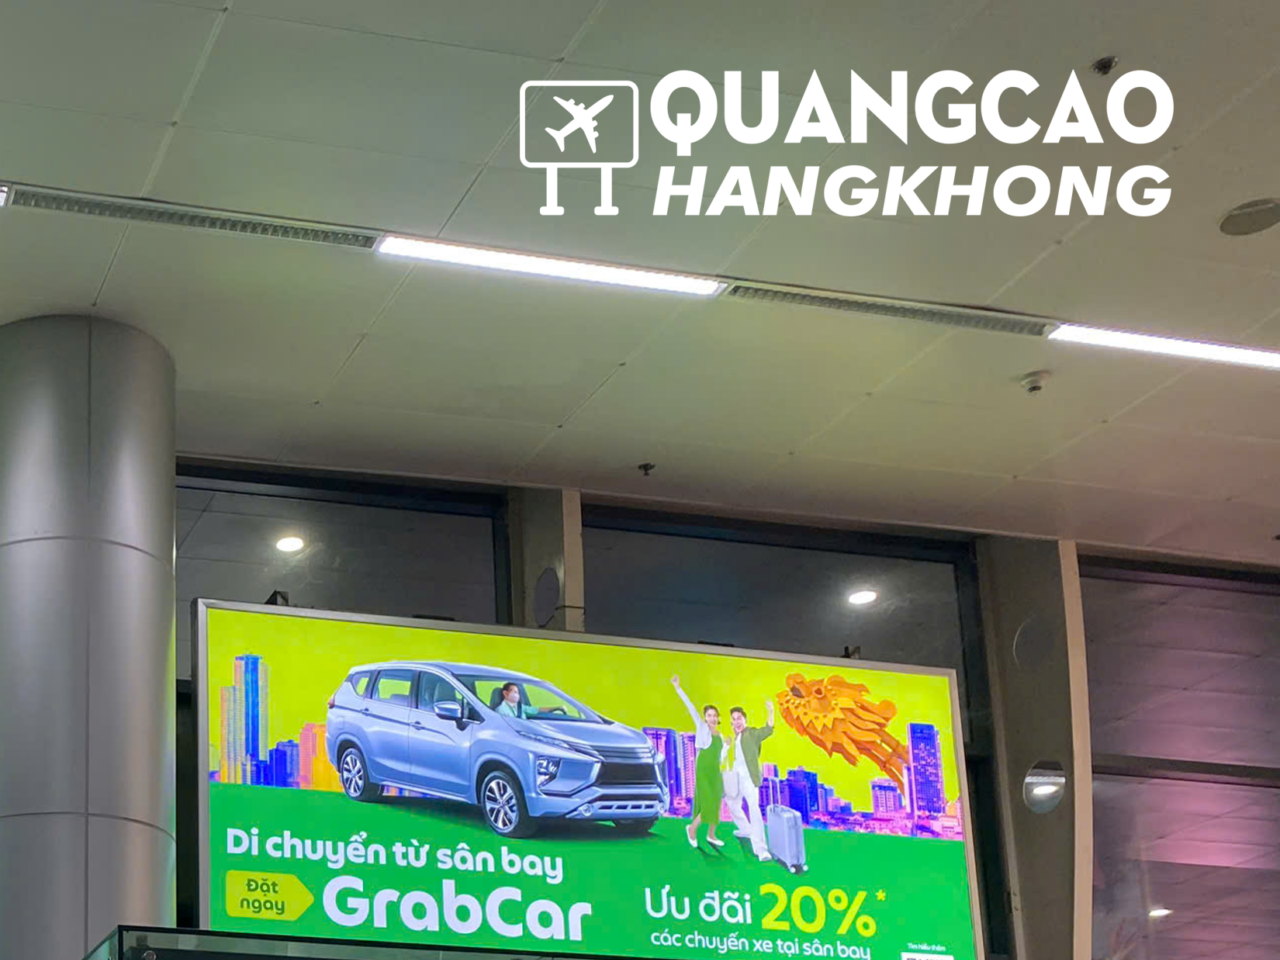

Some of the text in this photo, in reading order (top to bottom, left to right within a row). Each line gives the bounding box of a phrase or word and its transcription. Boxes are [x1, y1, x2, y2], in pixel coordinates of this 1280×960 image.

[227, 827, 563, 885] Di chuyển từ sân bay
[246, 878, 278, 895] Đặt
[239, 898, 286, 915] ngay
[322, 875, 592, 942] GrabCar
[644, 885, 690, 920] Ưu
[699, 889, 752, 924] đãi
[651, 929, 682, 948] các
[685, 930, 749, 954] chuyến
[752, 938, 773, 952] xe
[776, 938, 799, 957] tại
[803, 938, 834, 957] sân
